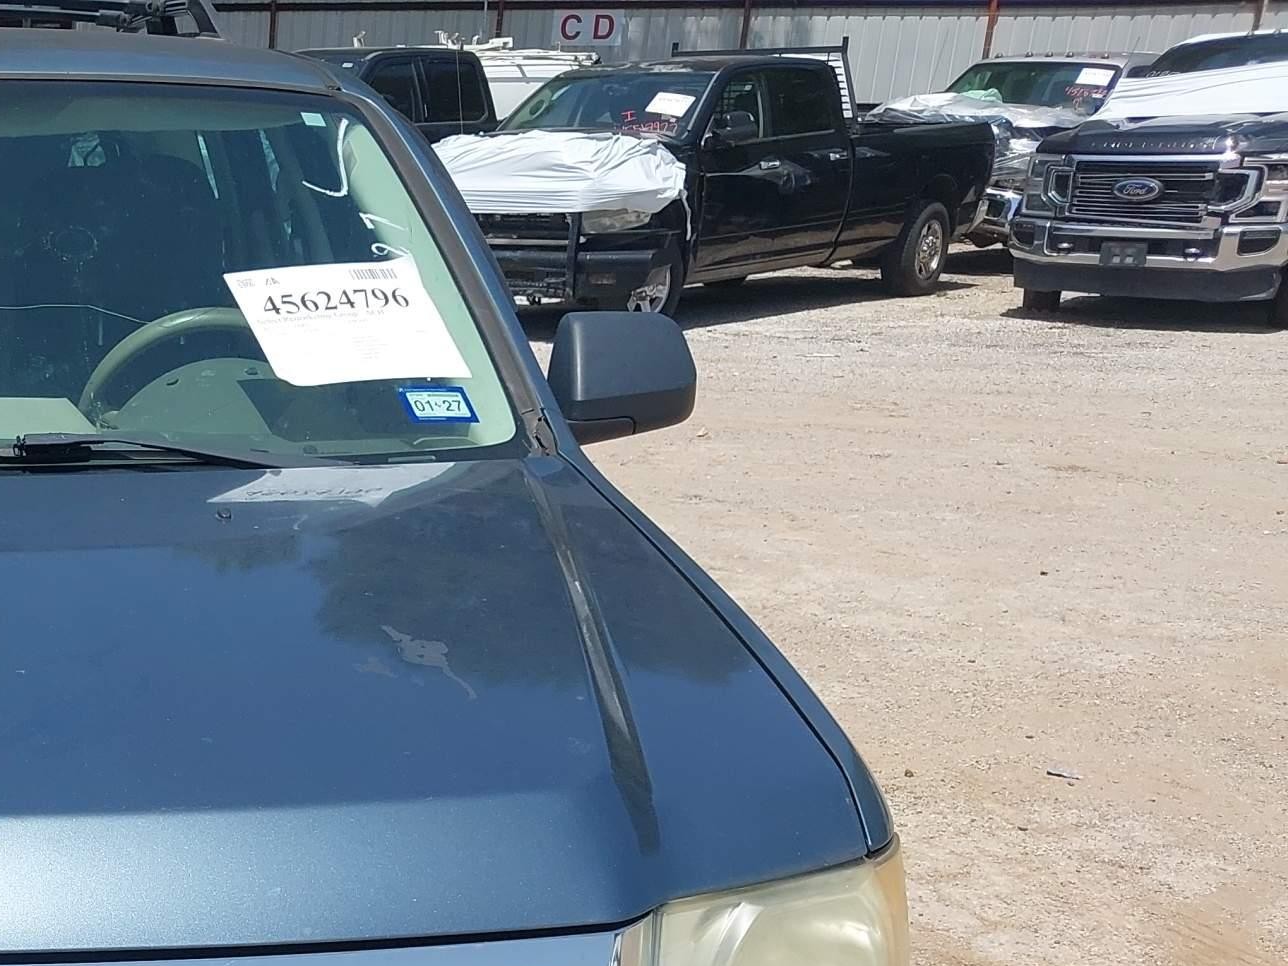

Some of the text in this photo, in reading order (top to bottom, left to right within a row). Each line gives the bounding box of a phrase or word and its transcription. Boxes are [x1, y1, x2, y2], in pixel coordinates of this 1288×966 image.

[560, 14, 614, 40] C D
[1123, 183, 1147, 196] Ford
[263, 286, 409, 315] 45624796
